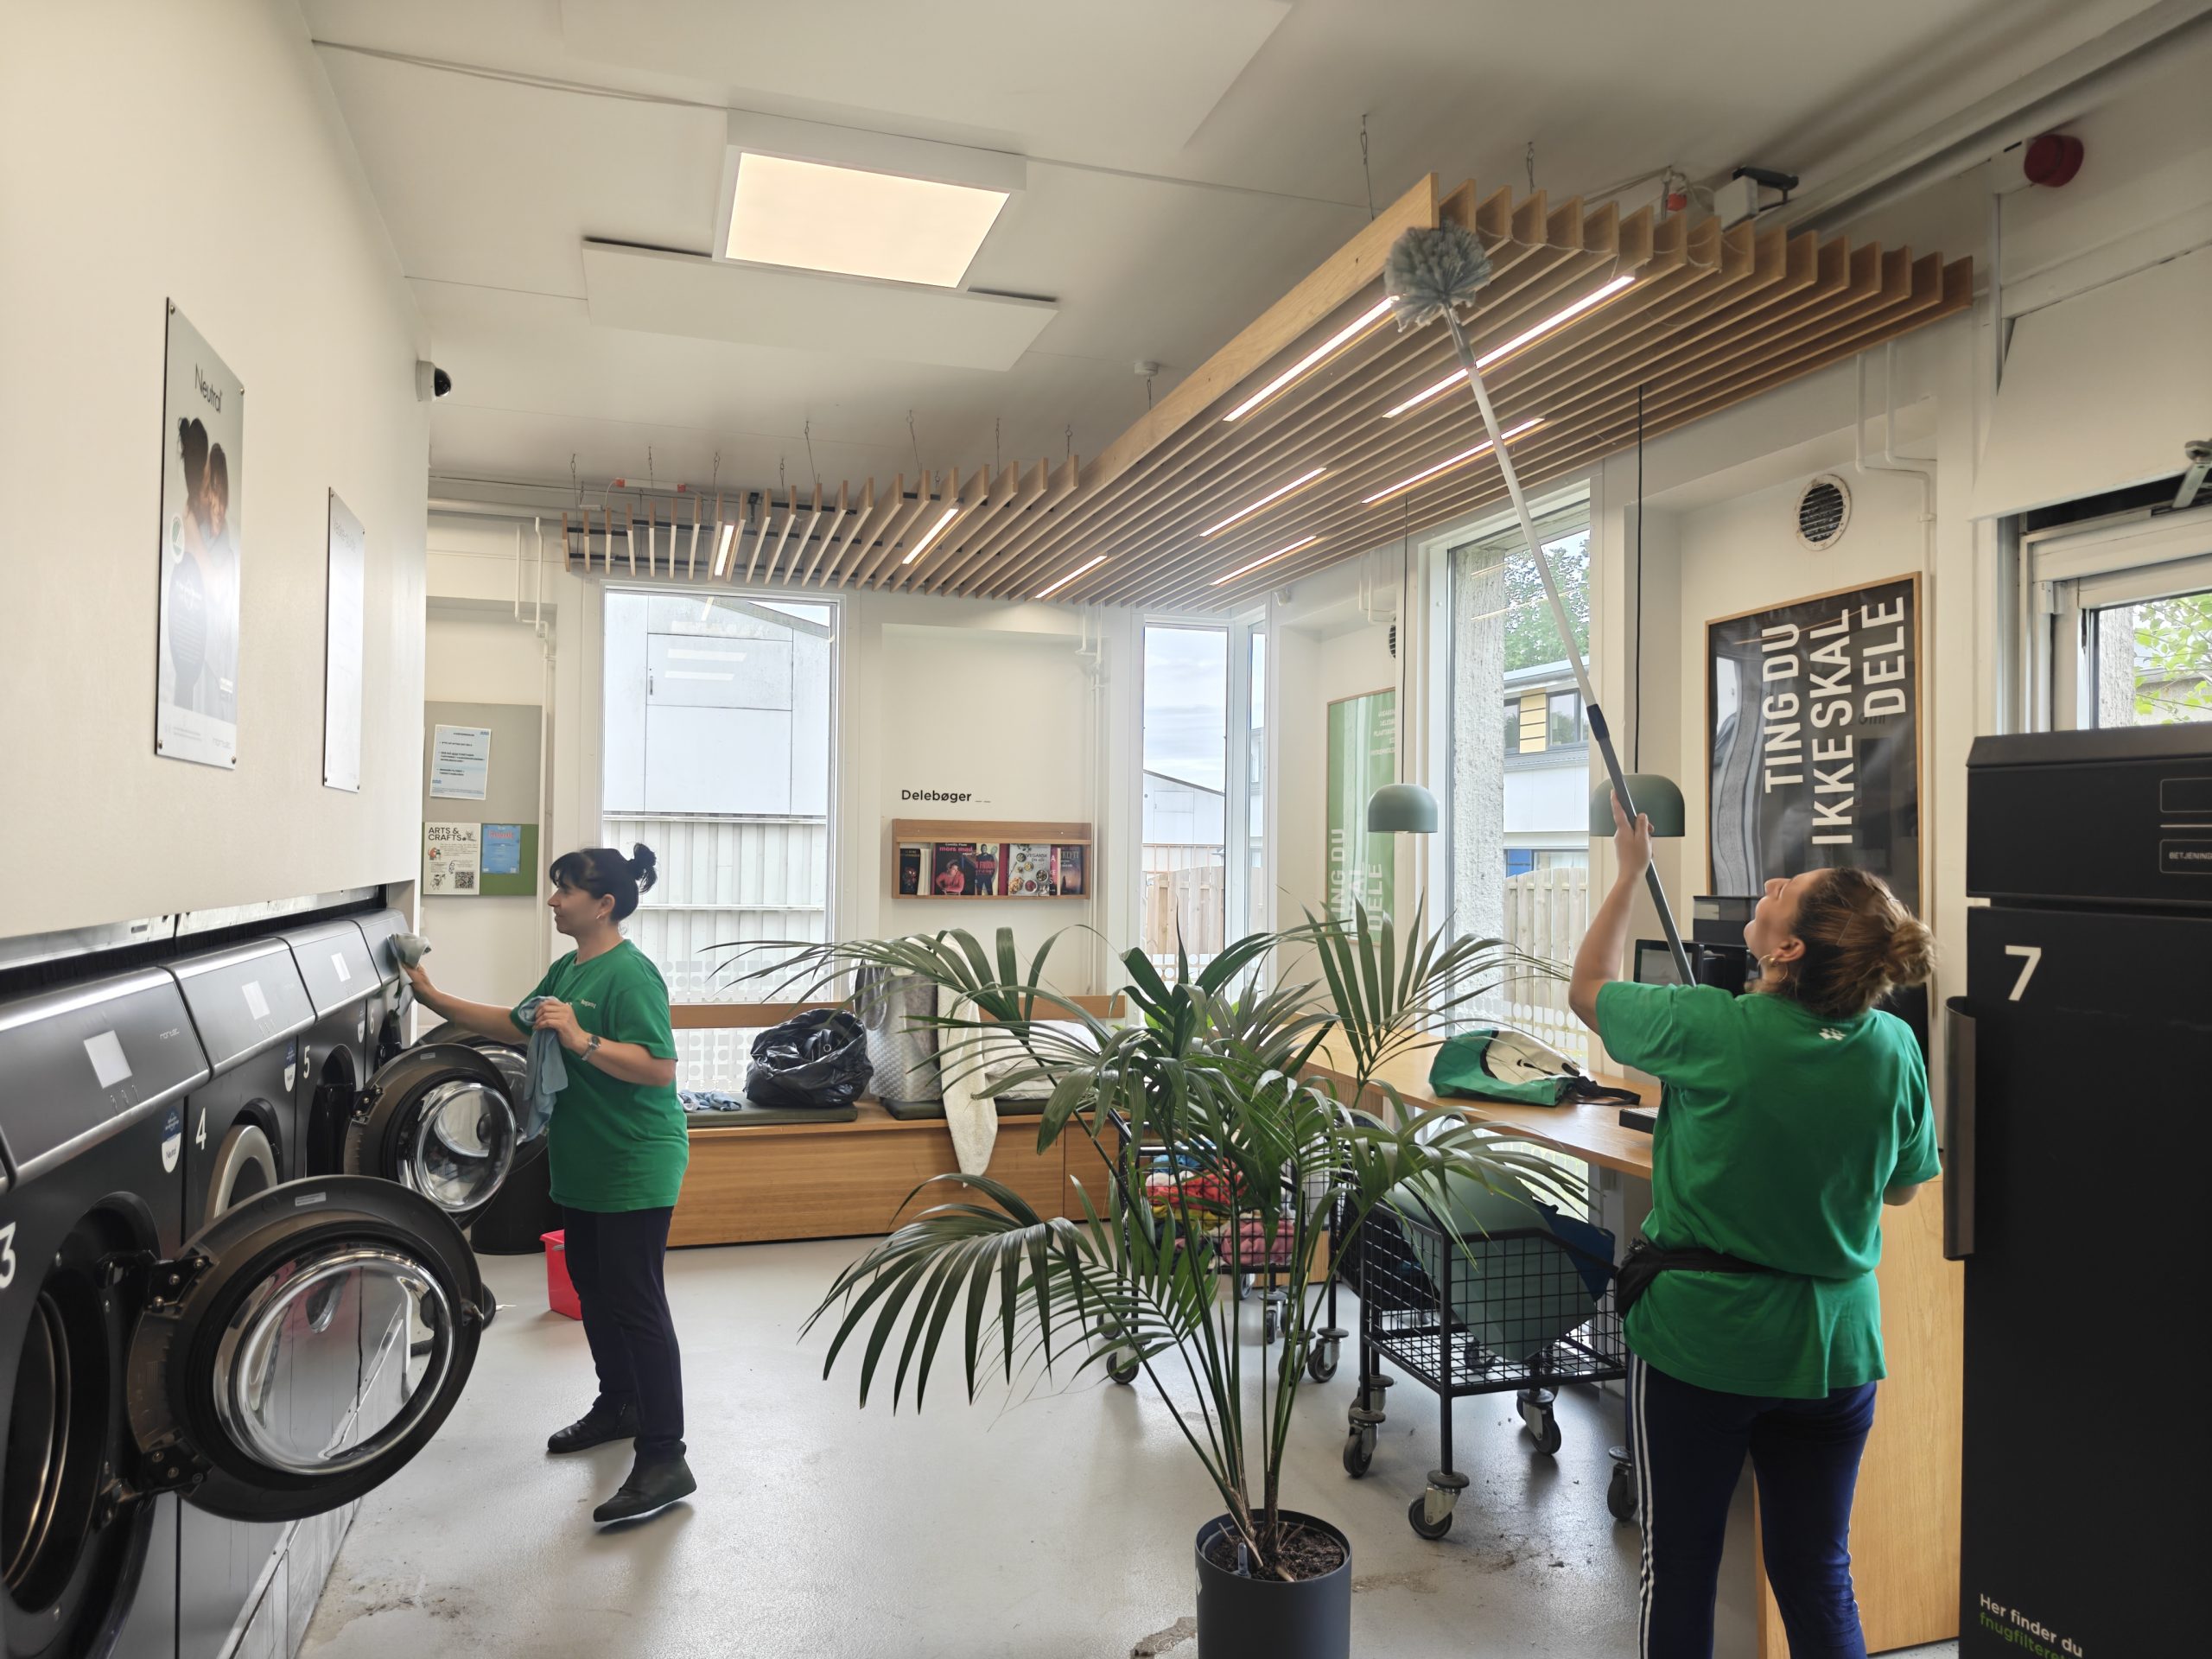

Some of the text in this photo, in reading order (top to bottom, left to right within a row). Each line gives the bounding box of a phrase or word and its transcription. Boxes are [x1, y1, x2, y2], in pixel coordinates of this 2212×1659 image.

[194, 362, 222, 414] Neutral
[1861, 597, 1906, 717] DELE
[1761, 623, 1803, 793] TING DU
[1809, 609, 1854, 844] IKKE SKAL
[901, 790, 972, 804] Delebøger
[1331, 829, 1345, 862] DU
[1368, 863, 1383, 931] DELE
[2005, 944, 2042, 1001] 7
[370, 1007, 375, 1034] 6
[303, 1045, 310, 1079] 5
[195, 1107, 207, 1151] 4
[0, 1221, 16, 1289] 3
[1980, 1593, 2082, 1658] Her finder du
